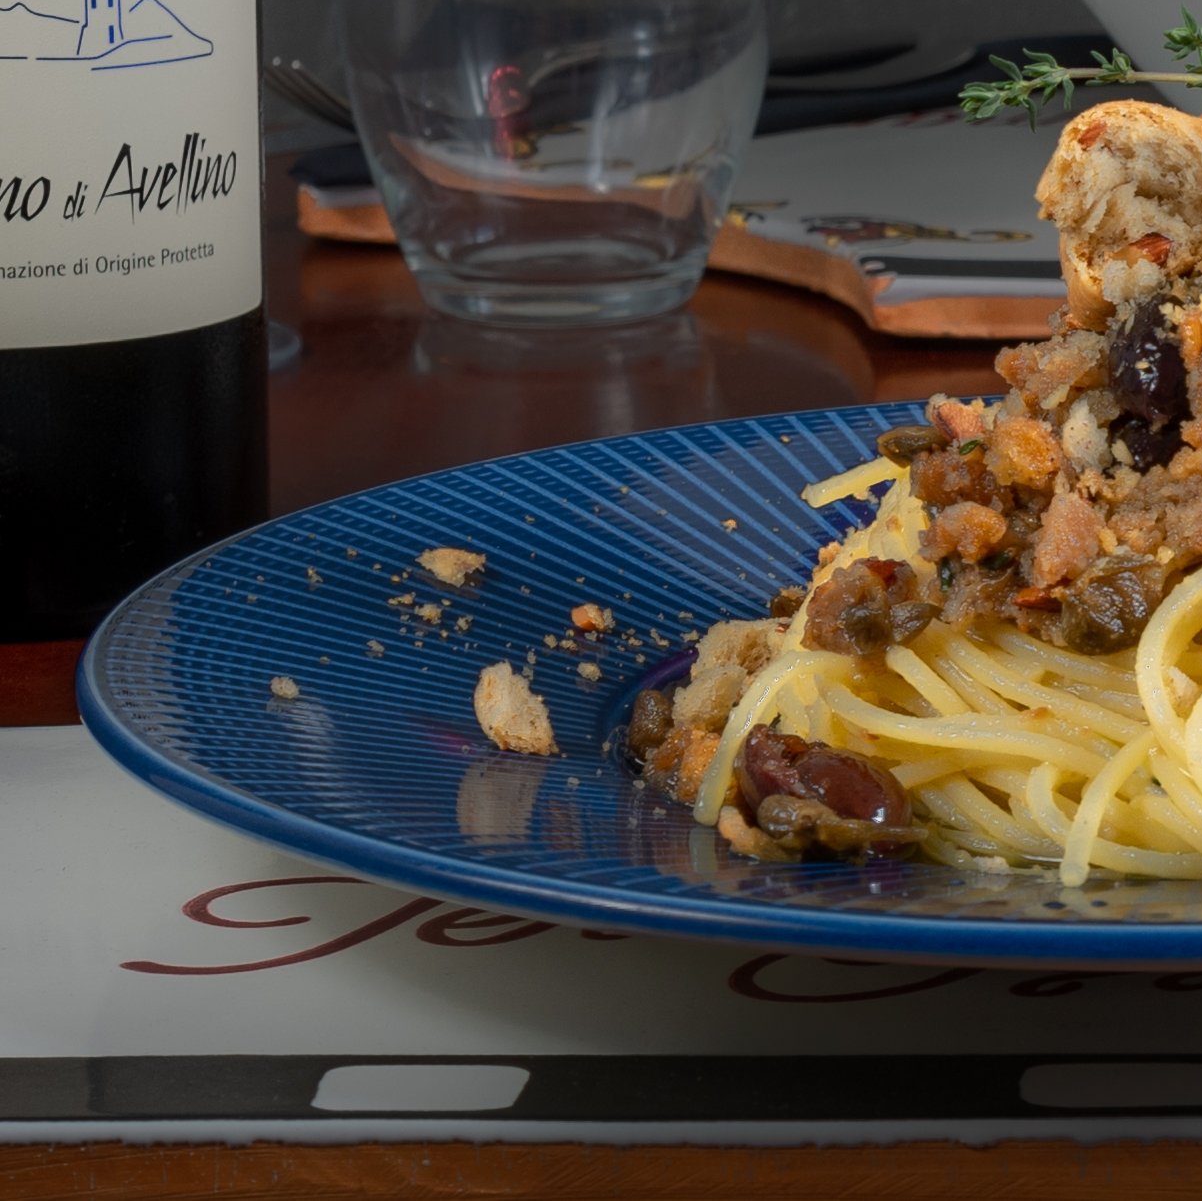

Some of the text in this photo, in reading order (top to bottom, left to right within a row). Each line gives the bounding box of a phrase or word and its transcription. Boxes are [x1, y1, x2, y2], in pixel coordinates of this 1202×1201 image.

[63, 180, 88, 221] di
[94, 132, 237, 225] Avellino
[73, 258, 89, 275] di
[95, 253, 156, 276] Origine
[161, 243, 214, 266] Protetta
